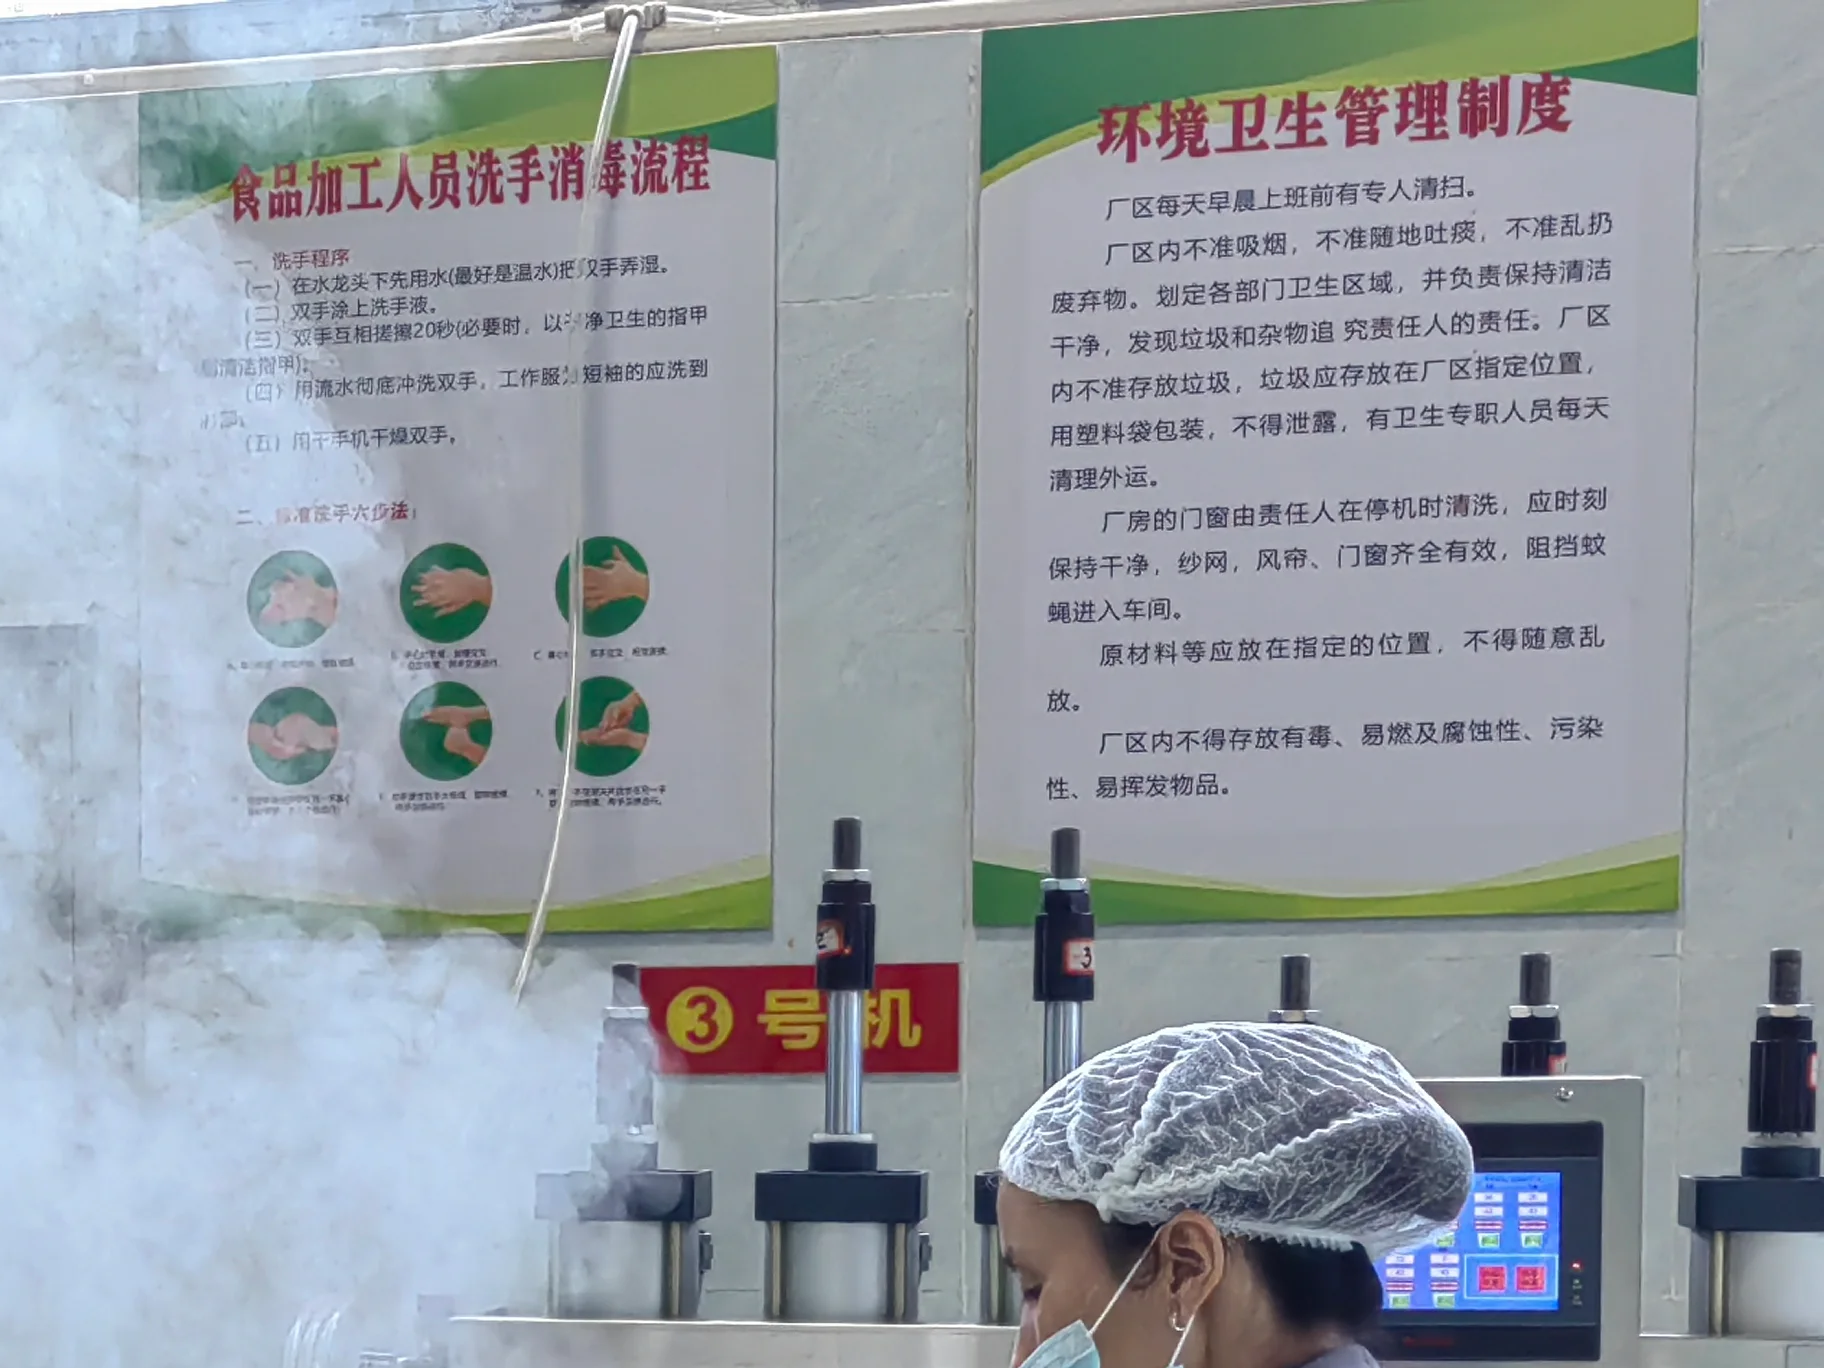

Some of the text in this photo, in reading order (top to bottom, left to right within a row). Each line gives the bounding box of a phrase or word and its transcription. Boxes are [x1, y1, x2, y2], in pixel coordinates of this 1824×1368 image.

[1097, 71, 1574, 164] 环境卫生管理制度
[228, 134, 710, 222] 食品加工人员洗手消毒流程
[1105, 174, 1476, 222] 厂区每天早晨上班前有专人清扫。
[1105, 211, 1613, 265] 厂区内不准吸烟，不准随地吐痰，不准乱扔
[1051, 258, 1612, 314] 废弃物。划定各部门卫生区域，并负责保持清洁
[1051, 351, 1594, 403] 内不准存放垃圾，垃圾应存放在厂区指定位置，
[1050, 395, 1611, 447] 用塑料袋包装，不得泄露，有卫生专职人员每天
[1049, 465, 1159, 491] 清理外运。
[1101, 487, 1608, 533] 厂房的门窗由责任人在停机时清洗，应时刻
[1048, 533, 1607, 580] 保持干净，纱网，风帘、门窗齐全有效，阻挡蚊
[1047, 598, 1183, 624] 蝇进入车间。
[1099, 624, 1606, 667] 原材料等应放在指定的位置，不得随意乱
[1046, 688, 1082, 712] 放。
[1099, 716, 1604, 755] 厂区内不得存放有毒、易燃及腐蚀性、污染
[1046, 773, 1231, 800] 性、易挥发物品。
